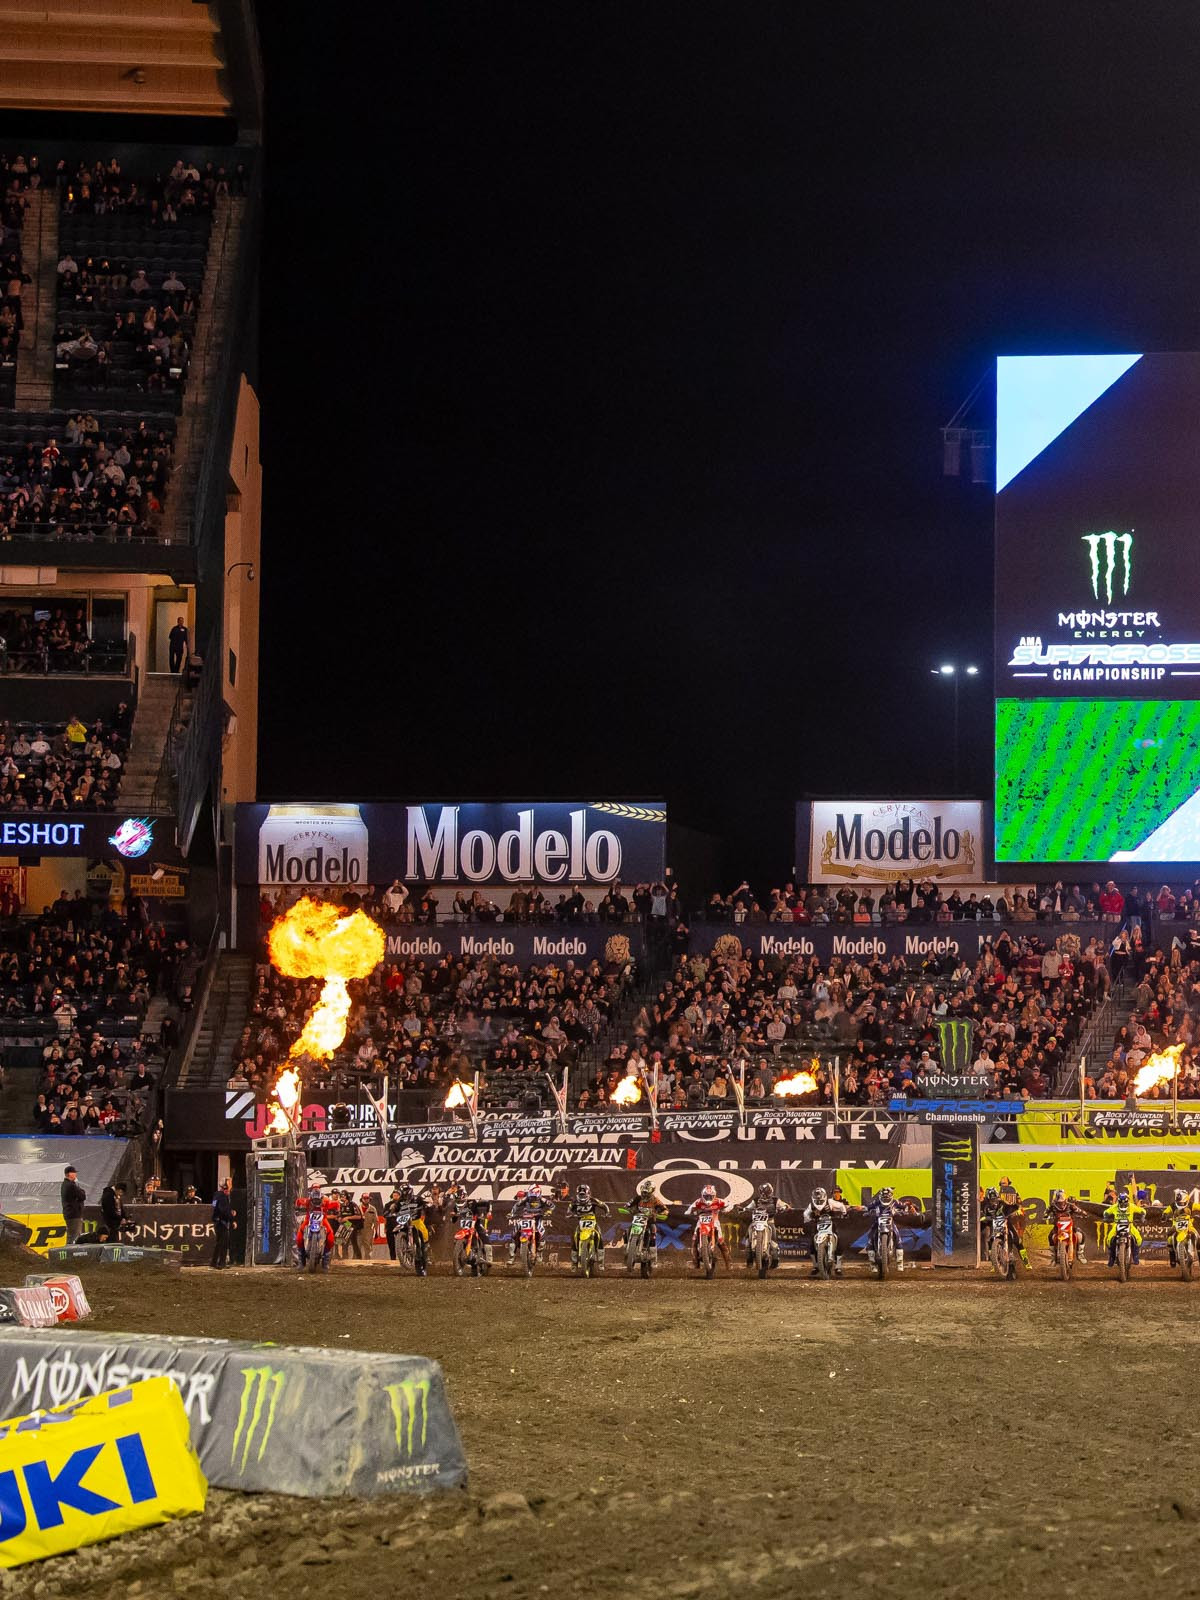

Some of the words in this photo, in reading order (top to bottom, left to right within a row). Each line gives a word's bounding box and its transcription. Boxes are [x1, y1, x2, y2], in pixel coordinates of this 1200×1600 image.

[1057, 609, 1161, 629] MONSTER
[1019, 636, 1042, 646] AMA
[1074, 630, 1146, 638] ENERGY
[1053, 668, 1166, 681] CHAMPIONSHIP
[872, 804, 923, 818] CERVEZA
[0, 822, 85, 845] ESHOT
[293, 830, 337, 841] CERVEZA
[835, 813, 961, 861] Modelo
[404, 805, 623, 882] Modelo
[265, 843, 360, 884] Modelo
[387, 936, 441, 956] Modelo
[460, 936, 514, 956] Modelo
[533, 936, 587, 956] Modelo
[760, 935, 814, 955] Modelo
[833, 935, 886, 955] Modelo
[905, 935, 959, 955] Modelo
[917, 1074, 990, 1087] MONSTER
[887, 1100, 1026, 1114] SUPERCROSS
[584, 1117, 606, 1125] ROCKY
[675, 1114, 697, 1122] ROCKY
[925, 1112, 986, 1123] Championship
[1104, 1111, 1127, 1119] ROCKY
[405, 1126, 428, 1135] ROCKY
[429, 1125, 464, 1134] MOUNTAIN
[493, 1121, 515, 1129] ROCKY
[516, 1120, 551, 1128] MOUNTAIN
[318, 1131, 341, 1140] ROCKY
[341, 1131, 377, 1139] MOUNTAIN
[430, 1146, 504, 1162] ROCKY
[504, 1145, 627, 1163] MOUNTAIN
[333, 1168, 411, 1183] ROCKY
[420, 1167, 555, 1183] MOUNTAIN
[961, 1182, 971, 1233] MONSTER
[521, 1220, 532, 1228] 51
[582, 1220, 593, 1229] 12
[700, 1215, 712, 1223] 125
[1058, 1221, 1071, 1231] 7
[376, 1463, 441, 1482] MONSTER
